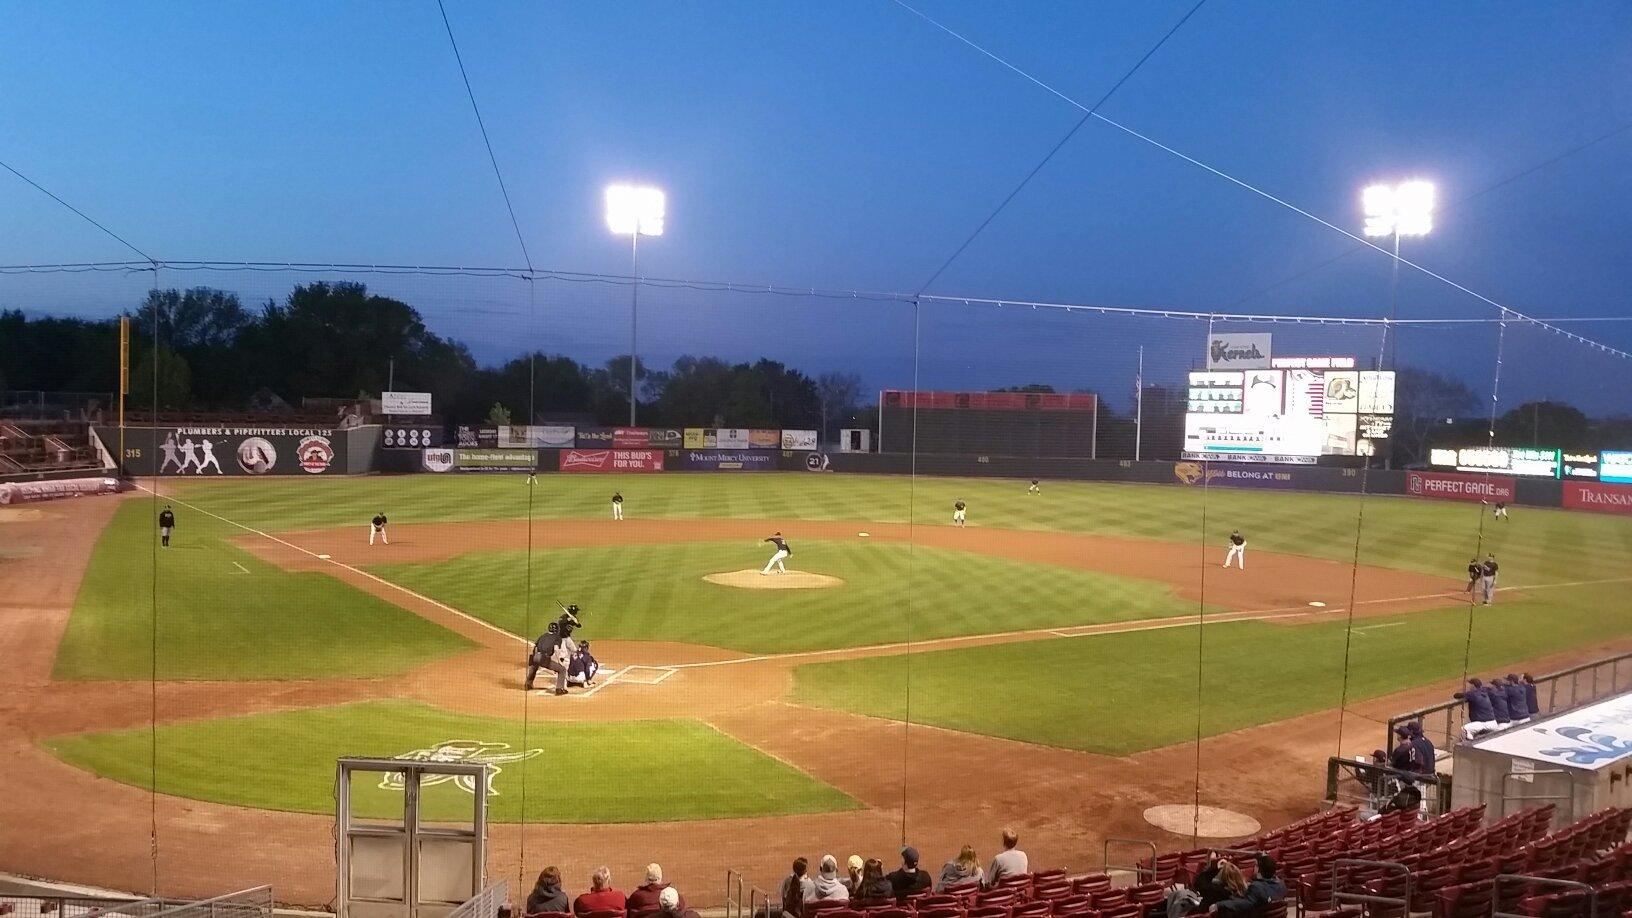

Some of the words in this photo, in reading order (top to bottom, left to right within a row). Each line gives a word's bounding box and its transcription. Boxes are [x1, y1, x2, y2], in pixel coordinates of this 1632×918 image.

[1211, 339, 1265, 363] Kernels
[177, 428, 222, 436] PLUMBERS
[224, 428, 231, 436] &
[234, 428, 286, 436] PIPEFITTERS
[317, 429, 333, 437] 125
[125, 448, 141, 458] 315
[613, 452, 630, 460] THIS
[631, 452, 652, 460] BUD'S
[1182, 452, 1201, 460] BANK
[567, 454, 604, 463] Budweiser
[613, 460, 628, 468] FOR
[628, 460, 645, 468] YOU.
[1227, 470, 1261, 480] BELONG
[1262, 471, 1274, 480] AT
[1275, 472, 1291, 481] UNI
[1425, 479, 1465, 493] PERFECT
[1409, 747, 1416, 762] 12
